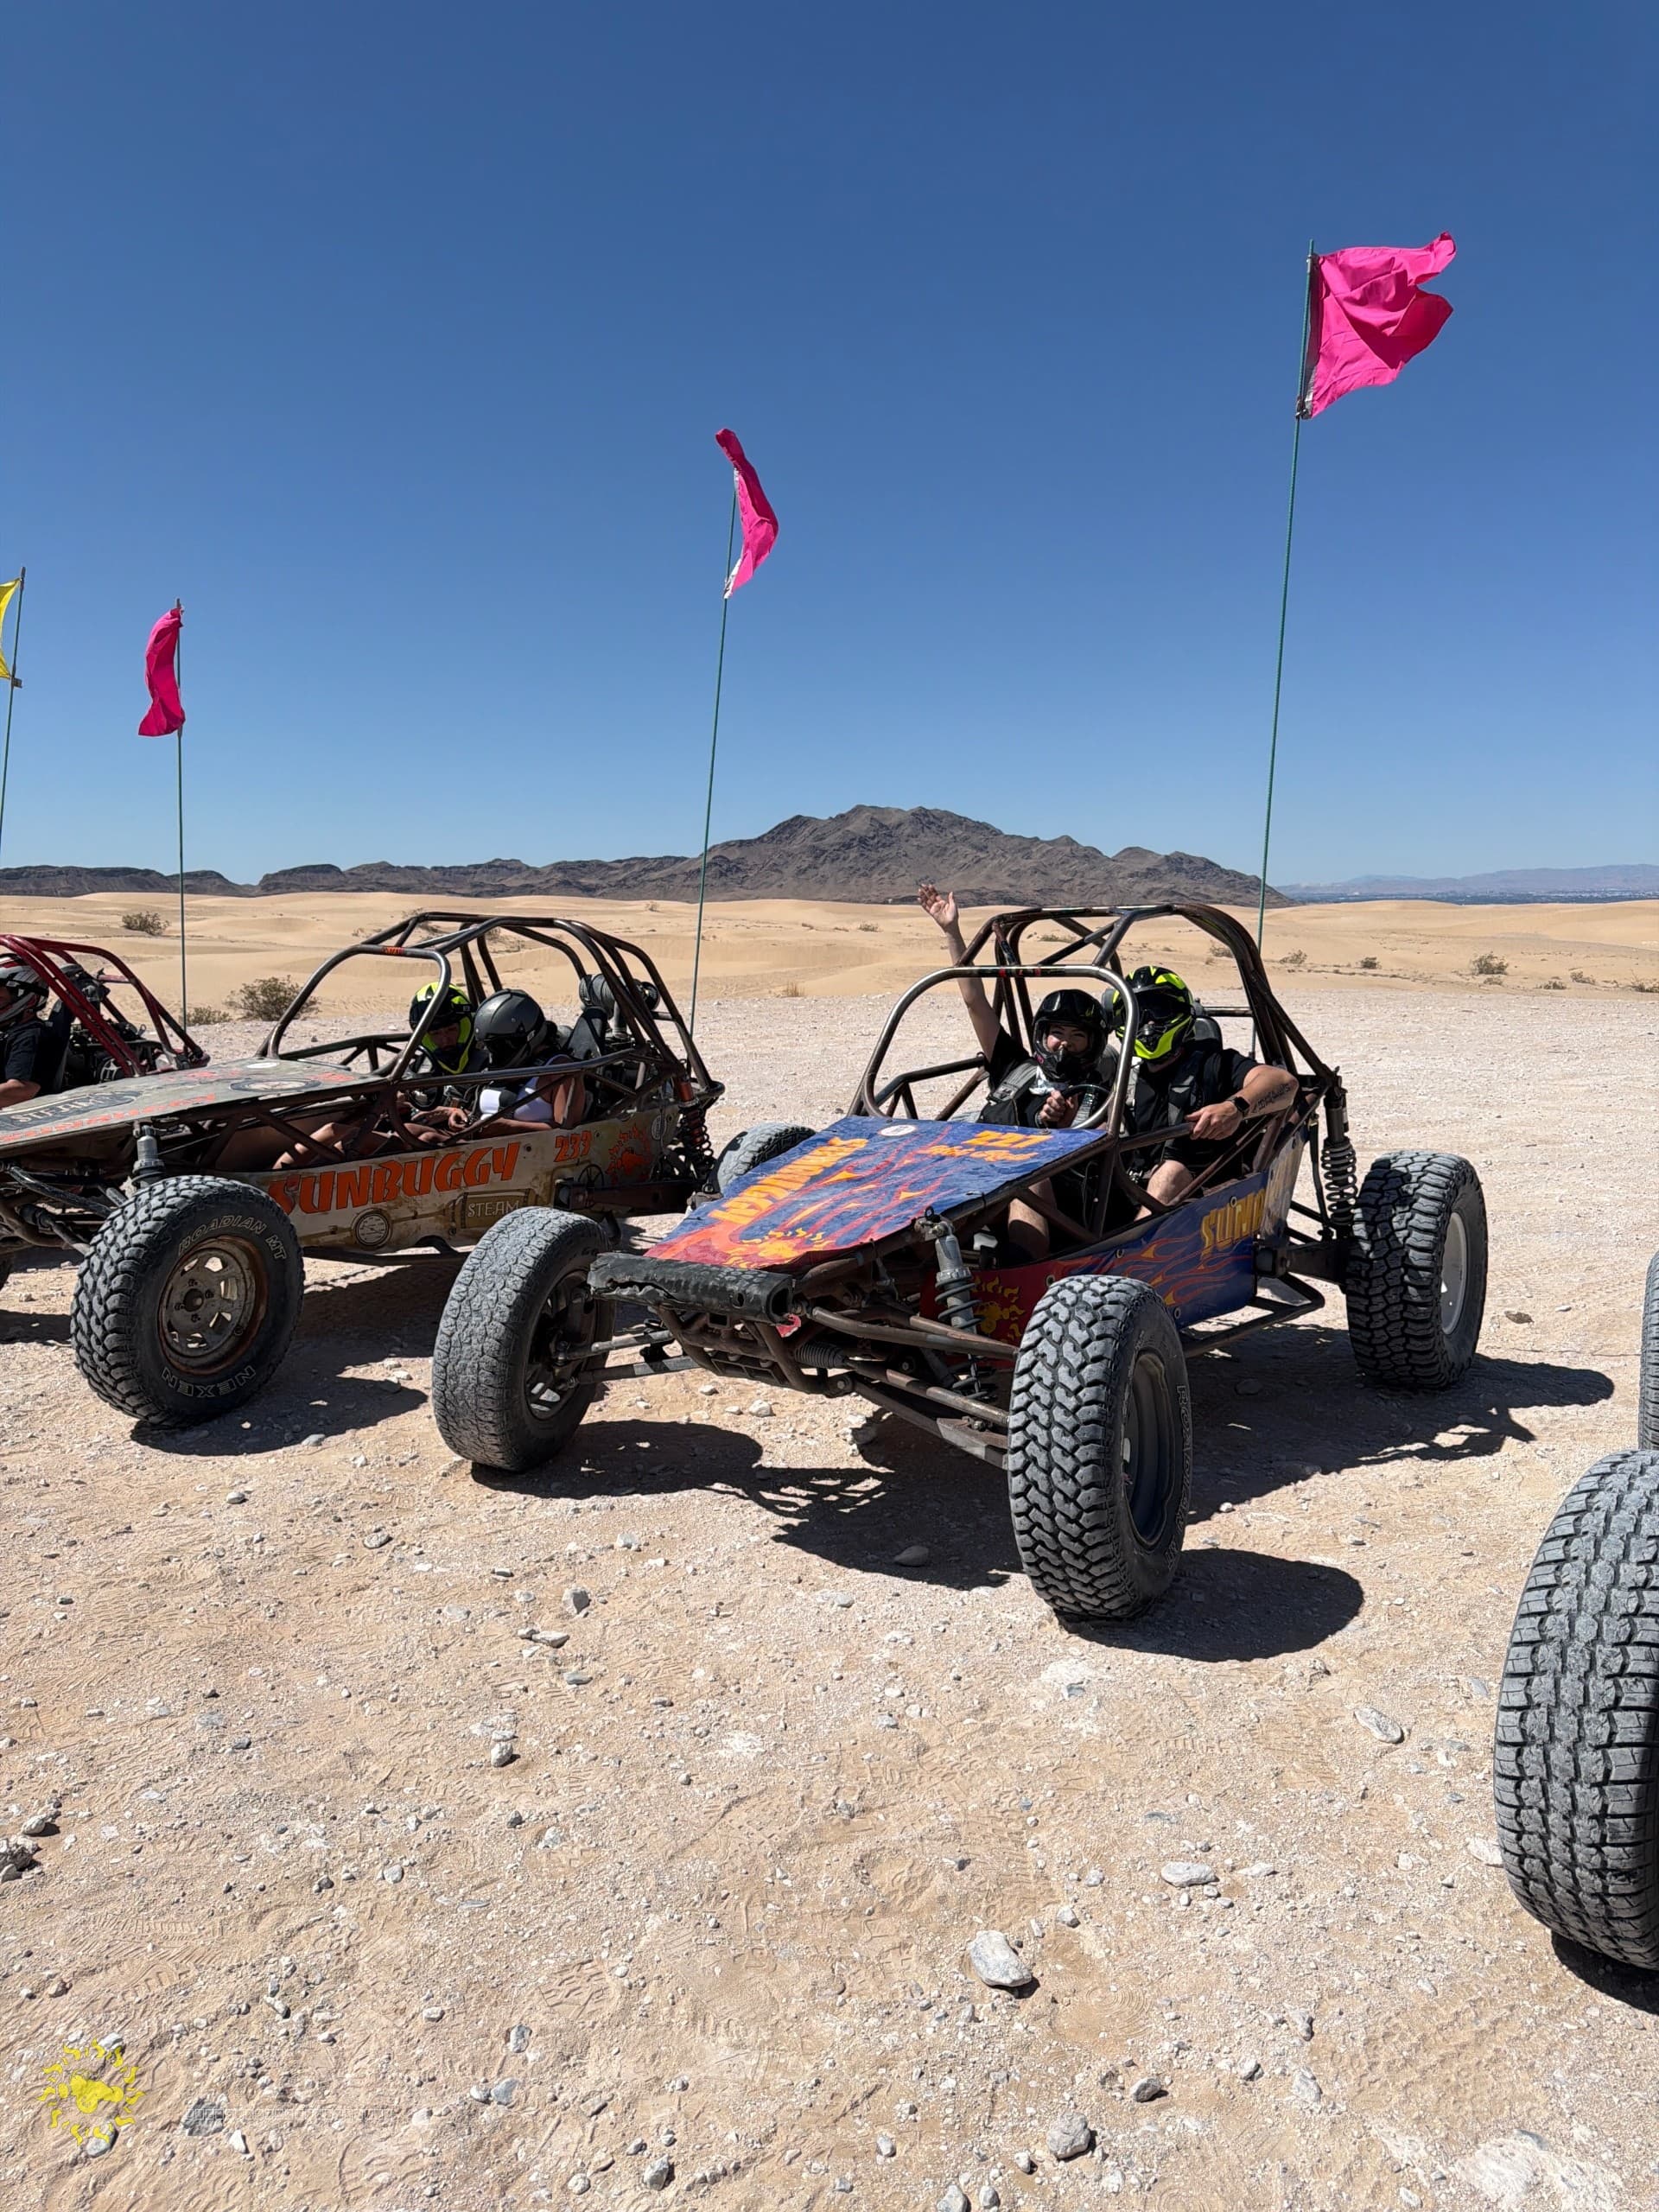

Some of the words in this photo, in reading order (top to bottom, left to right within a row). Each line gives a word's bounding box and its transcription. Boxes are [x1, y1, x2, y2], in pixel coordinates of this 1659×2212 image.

[269, 1142, 520, 1215] SUNBUGGY
[467, 1200, 518, 1217] STEAM
[178, 1215, 267, 1256] ROADIAN
[265, 1235, 287, 1261] MT
[162, 1365, 257, 1398] NEXEN
